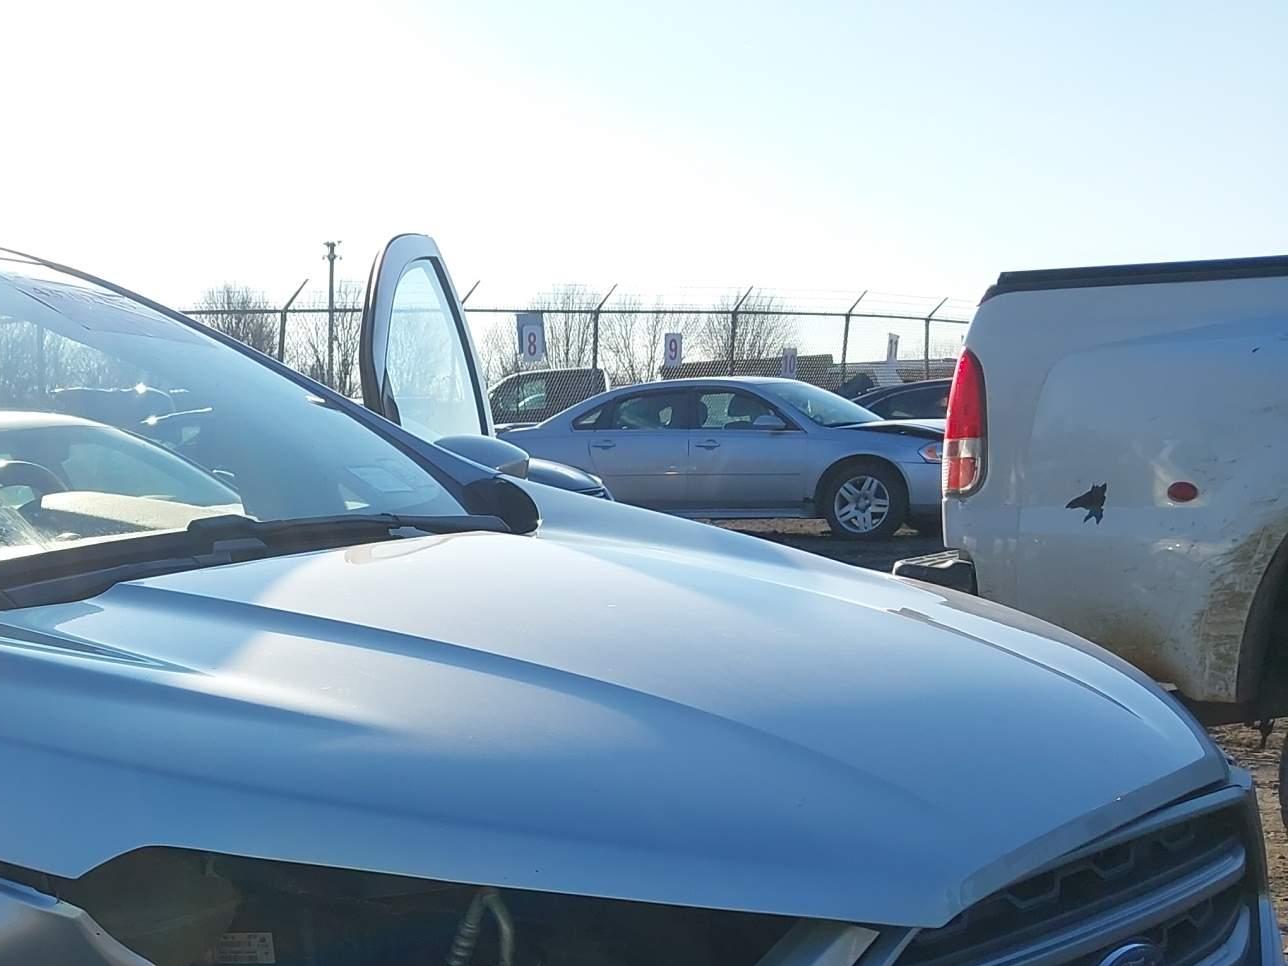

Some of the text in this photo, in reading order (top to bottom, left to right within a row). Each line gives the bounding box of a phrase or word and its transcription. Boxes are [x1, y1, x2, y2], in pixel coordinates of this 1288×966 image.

[527, 331, 537, 357] 8
[668, 338, 678, 361] 9
[784, 354, 796, 374] 10
